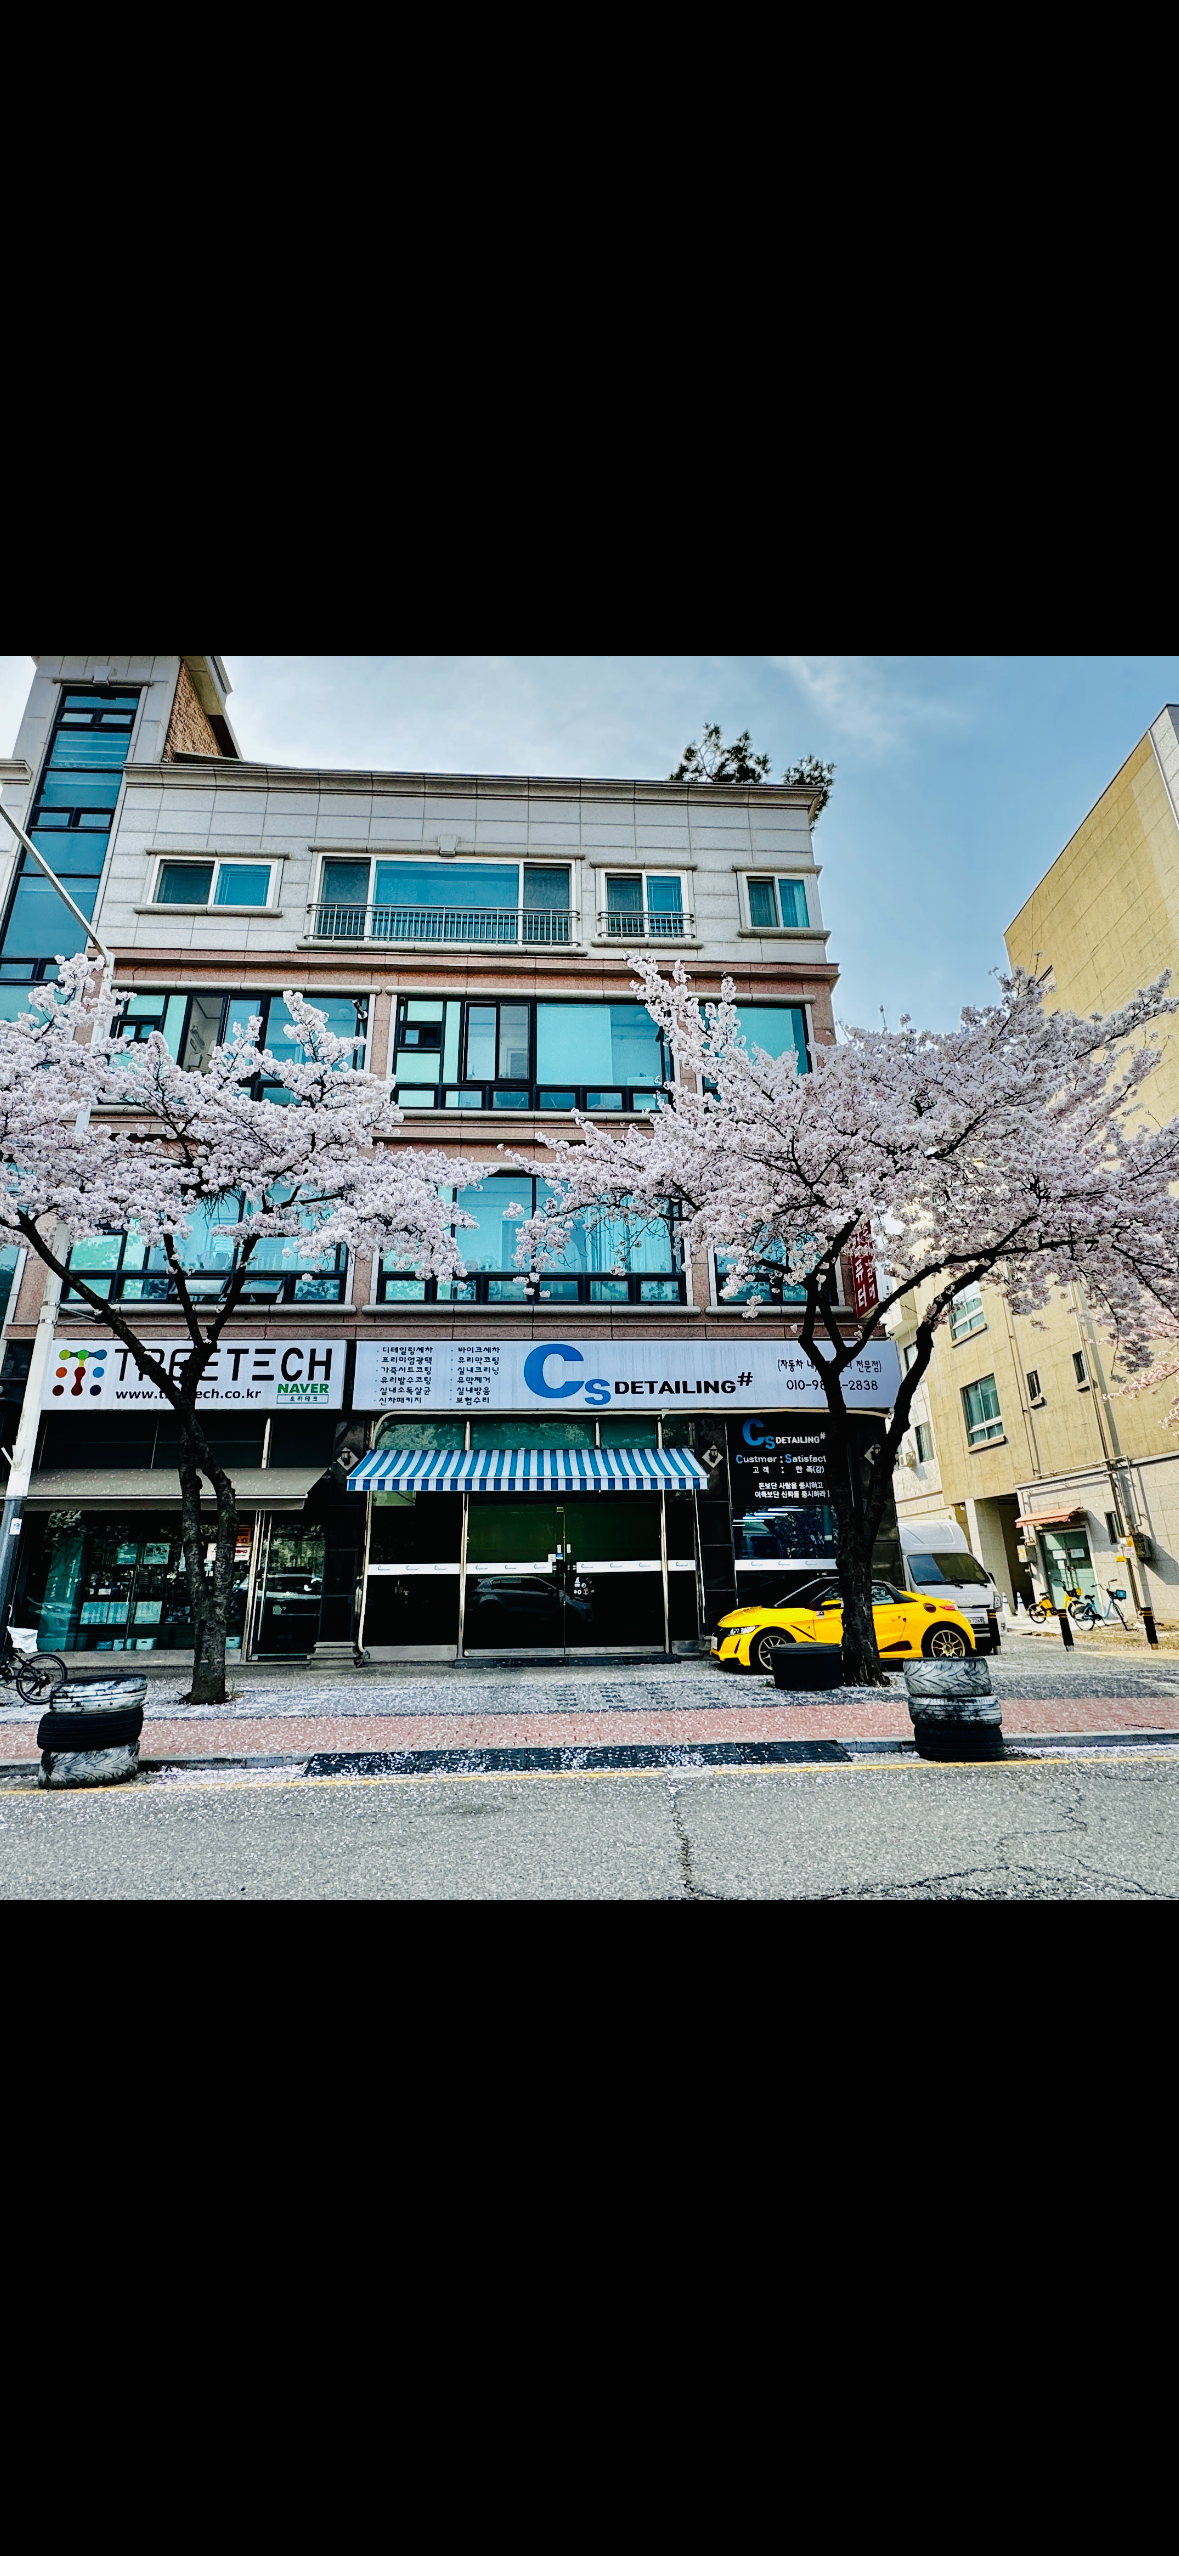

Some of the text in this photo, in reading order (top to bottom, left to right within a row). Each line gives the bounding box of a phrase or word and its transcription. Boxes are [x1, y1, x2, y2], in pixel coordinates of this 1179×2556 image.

[382, 1346, 434, 1356] 디테일링세차
[457, 1346, 500, 1354] 바이크세차
[381, 1356, 433, 1366] 프리미엄광택
[457, 1356, 500, 1366] 유리막코팅
[777, 1359, 804, 1373] (자동차
[855, 1359, 882, 1373] 전문점)
[380, 1366, 432, 1376] 가죽시트코팅
[457, 1366, 500, 1376] 실내크리닝
[380, 1376, 432, 1386] 유리발수코팅
[457, 1376, 491, 1386] 유막제거
[786, 1379, 879, 1391] 010-98-2838
[277, 1383, 329, 1394] NAVER
[379, 1386, 432, 1396] 실내소독살균
[456, 1386, 491, 1396] 실내방음
[378, 1396, 422, 1406] 신차패키지
[455, 1396, 490, 1406] 보험수리
